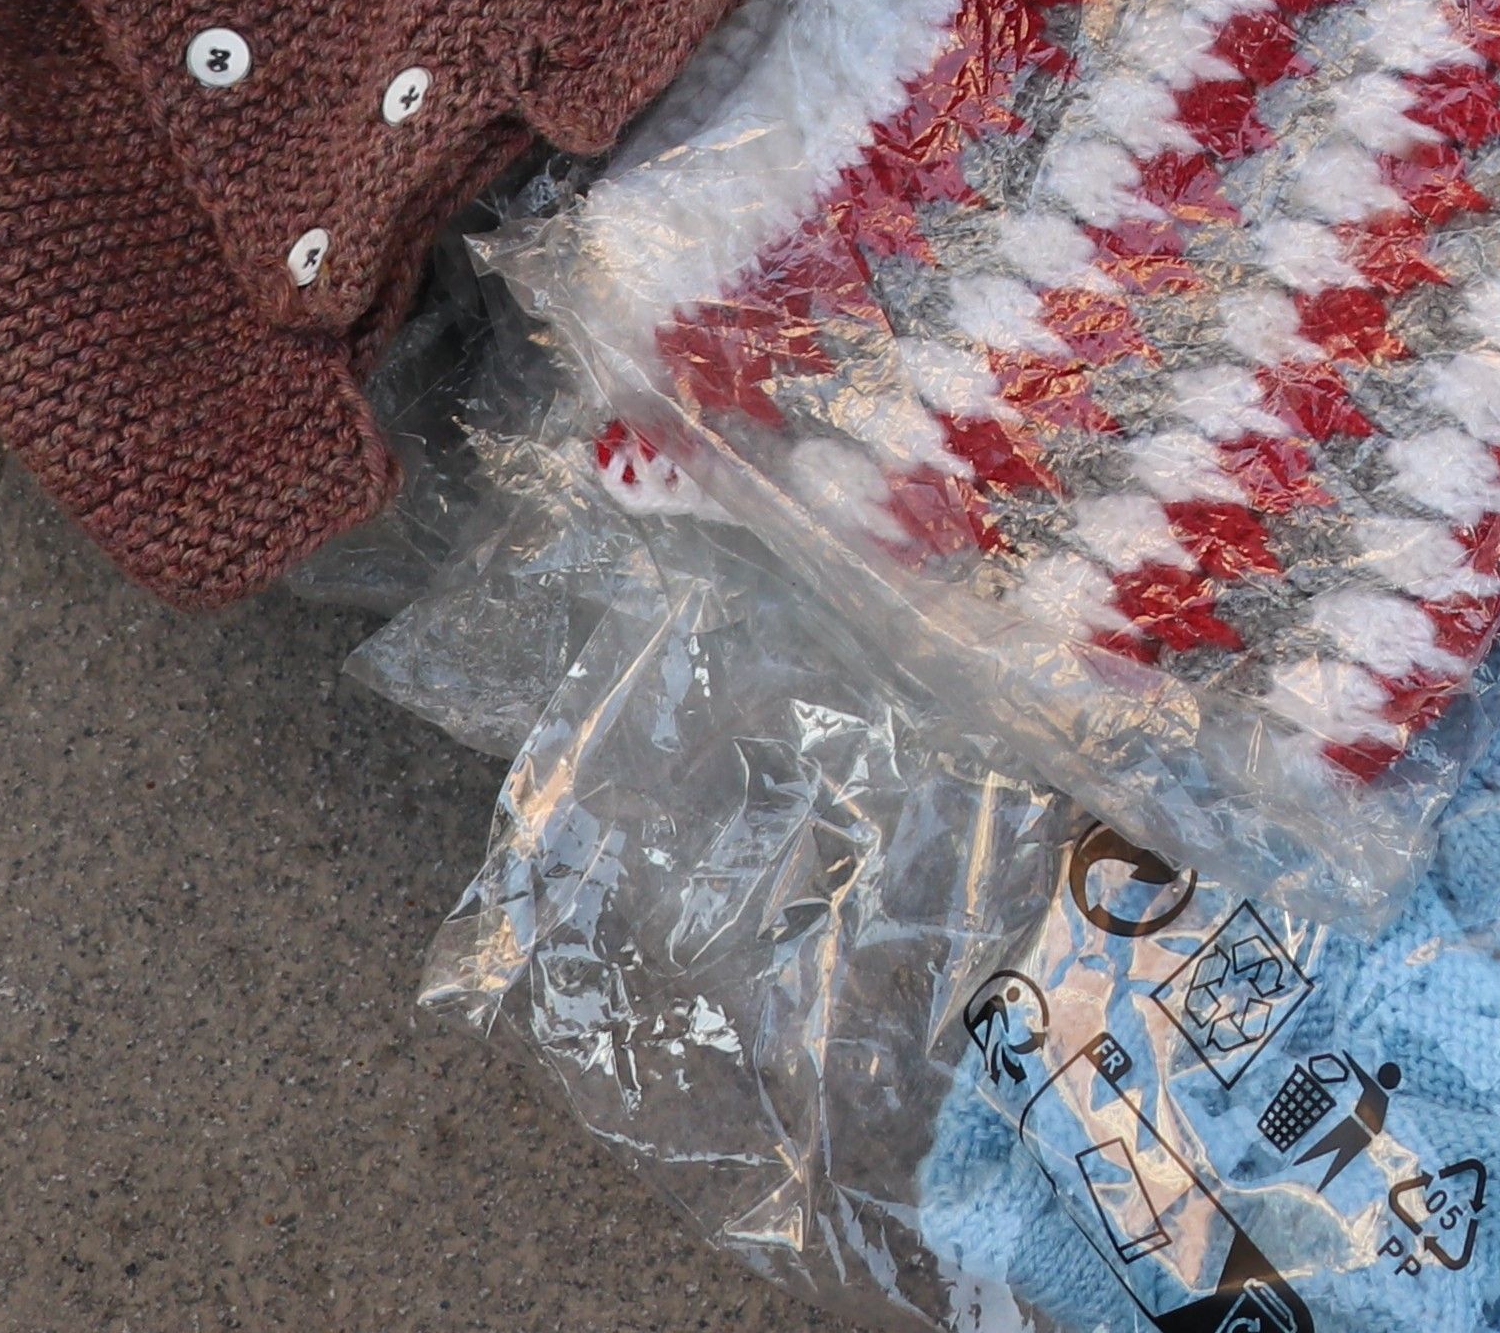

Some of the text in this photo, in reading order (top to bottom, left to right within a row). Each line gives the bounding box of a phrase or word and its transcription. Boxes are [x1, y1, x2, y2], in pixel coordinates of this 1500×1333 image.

[1092, 1039, 1125, 1074] FR
[1426, 1190, 1463, 1230] 05
[1377, 1235, 1421, 1276] PP
